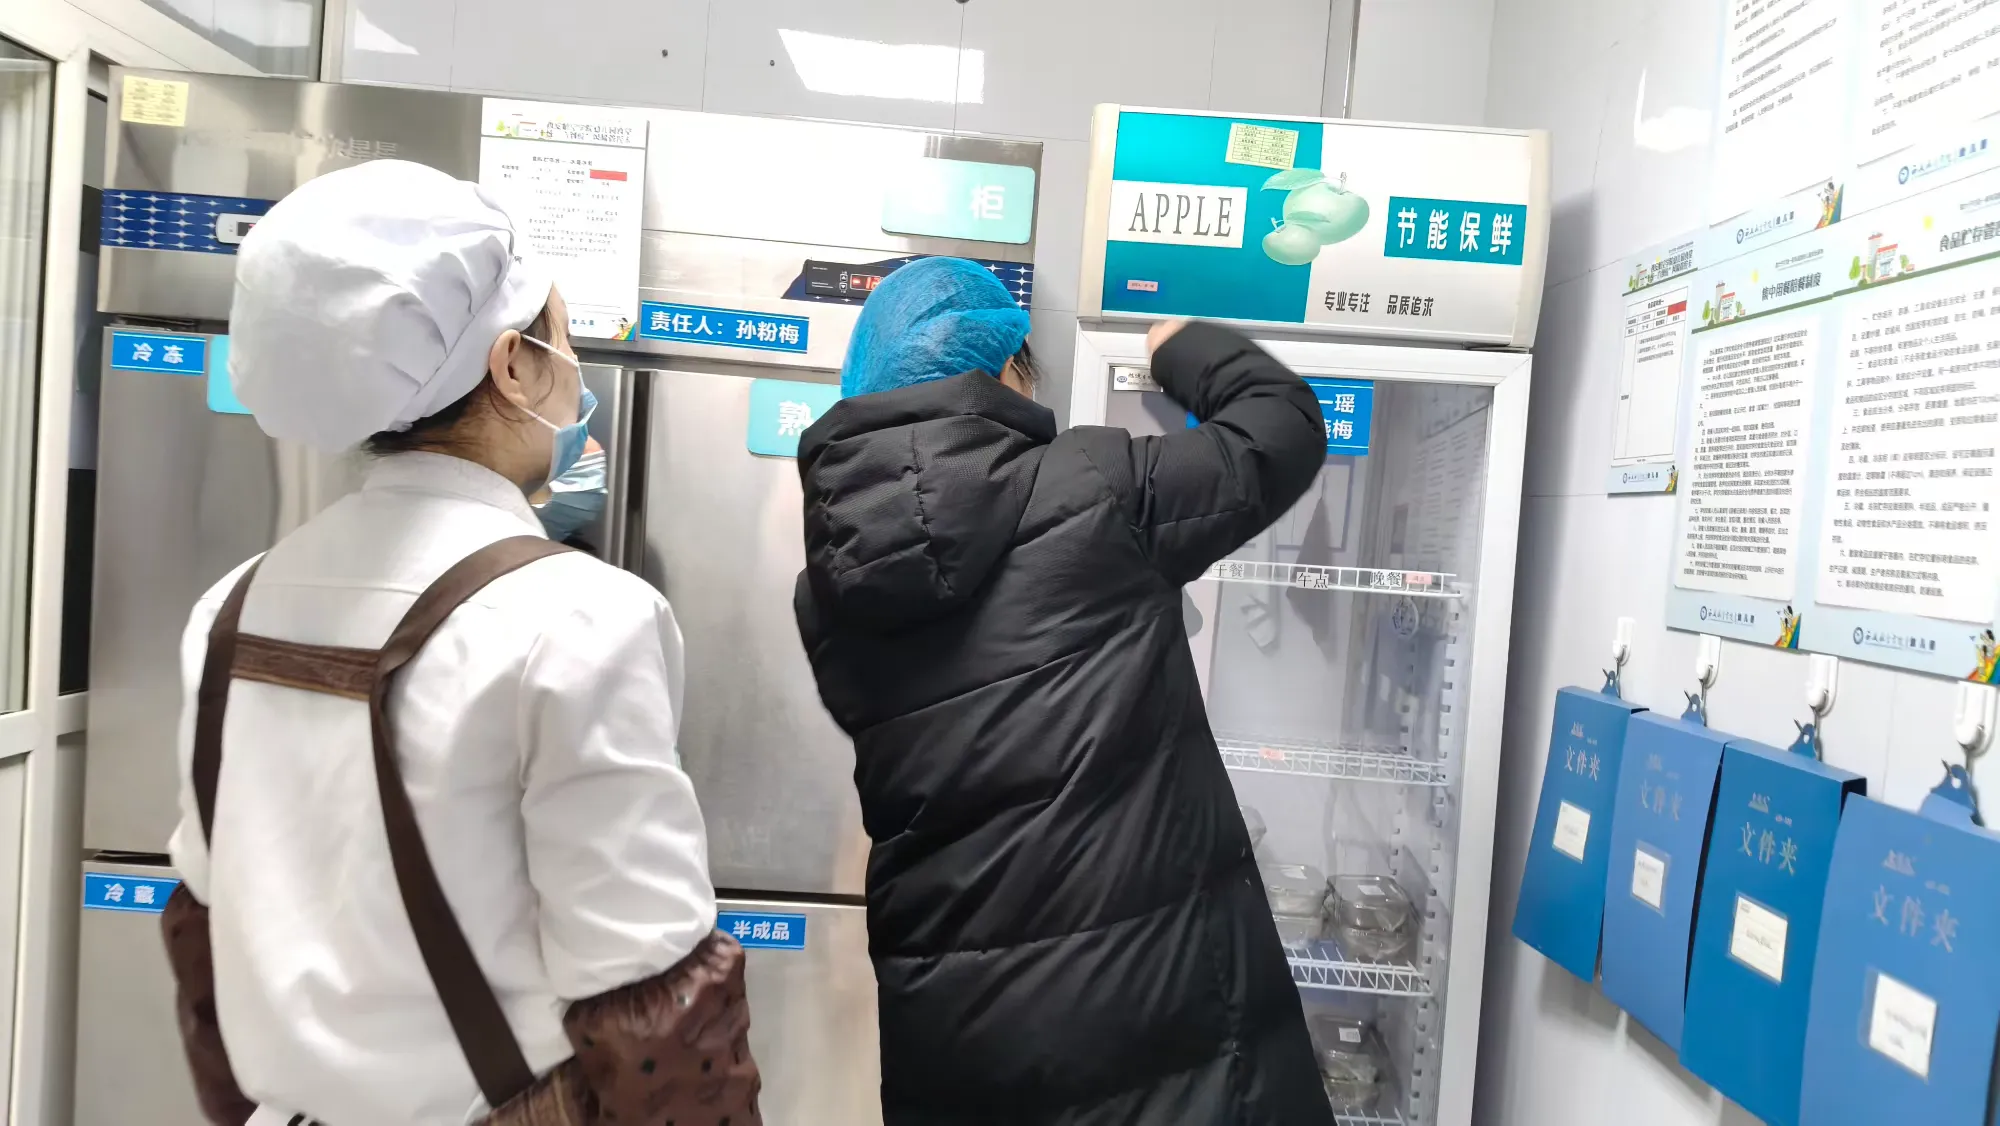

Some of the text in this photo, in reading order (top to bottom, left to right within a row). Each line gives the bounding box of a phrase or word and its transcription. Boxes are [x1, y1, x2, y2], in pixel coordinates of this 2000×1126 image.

[969, 184, 1005, 220] 柜
[1128, 191, 1233, 238] APPLE
[1397, 206, 1514, 255] 节能保鲜
[1324, 290, 1371, 314] 专业专注
[1386, 294, 1434, 317] 品质追求
[649, 311, 800, 345] 责任人：孙粉梅
[131, 342, 185, 365] 冷冻
[777, 400, 815, 436] 熟
[1211, 563, 1245, 578] 午餐
[1297, 572, 1329, 589] 午点
[1369, 570, 1402, 587] 晚餐
[1563, 744, 1601, 782] 文件夹
[1737, 821, 1798, 876] 文件夹
[103, 882, 156, 905] 冷藏
[732, 920, 791, 941] 半成品
[1869, 884, 1960, 952] 文件夹
